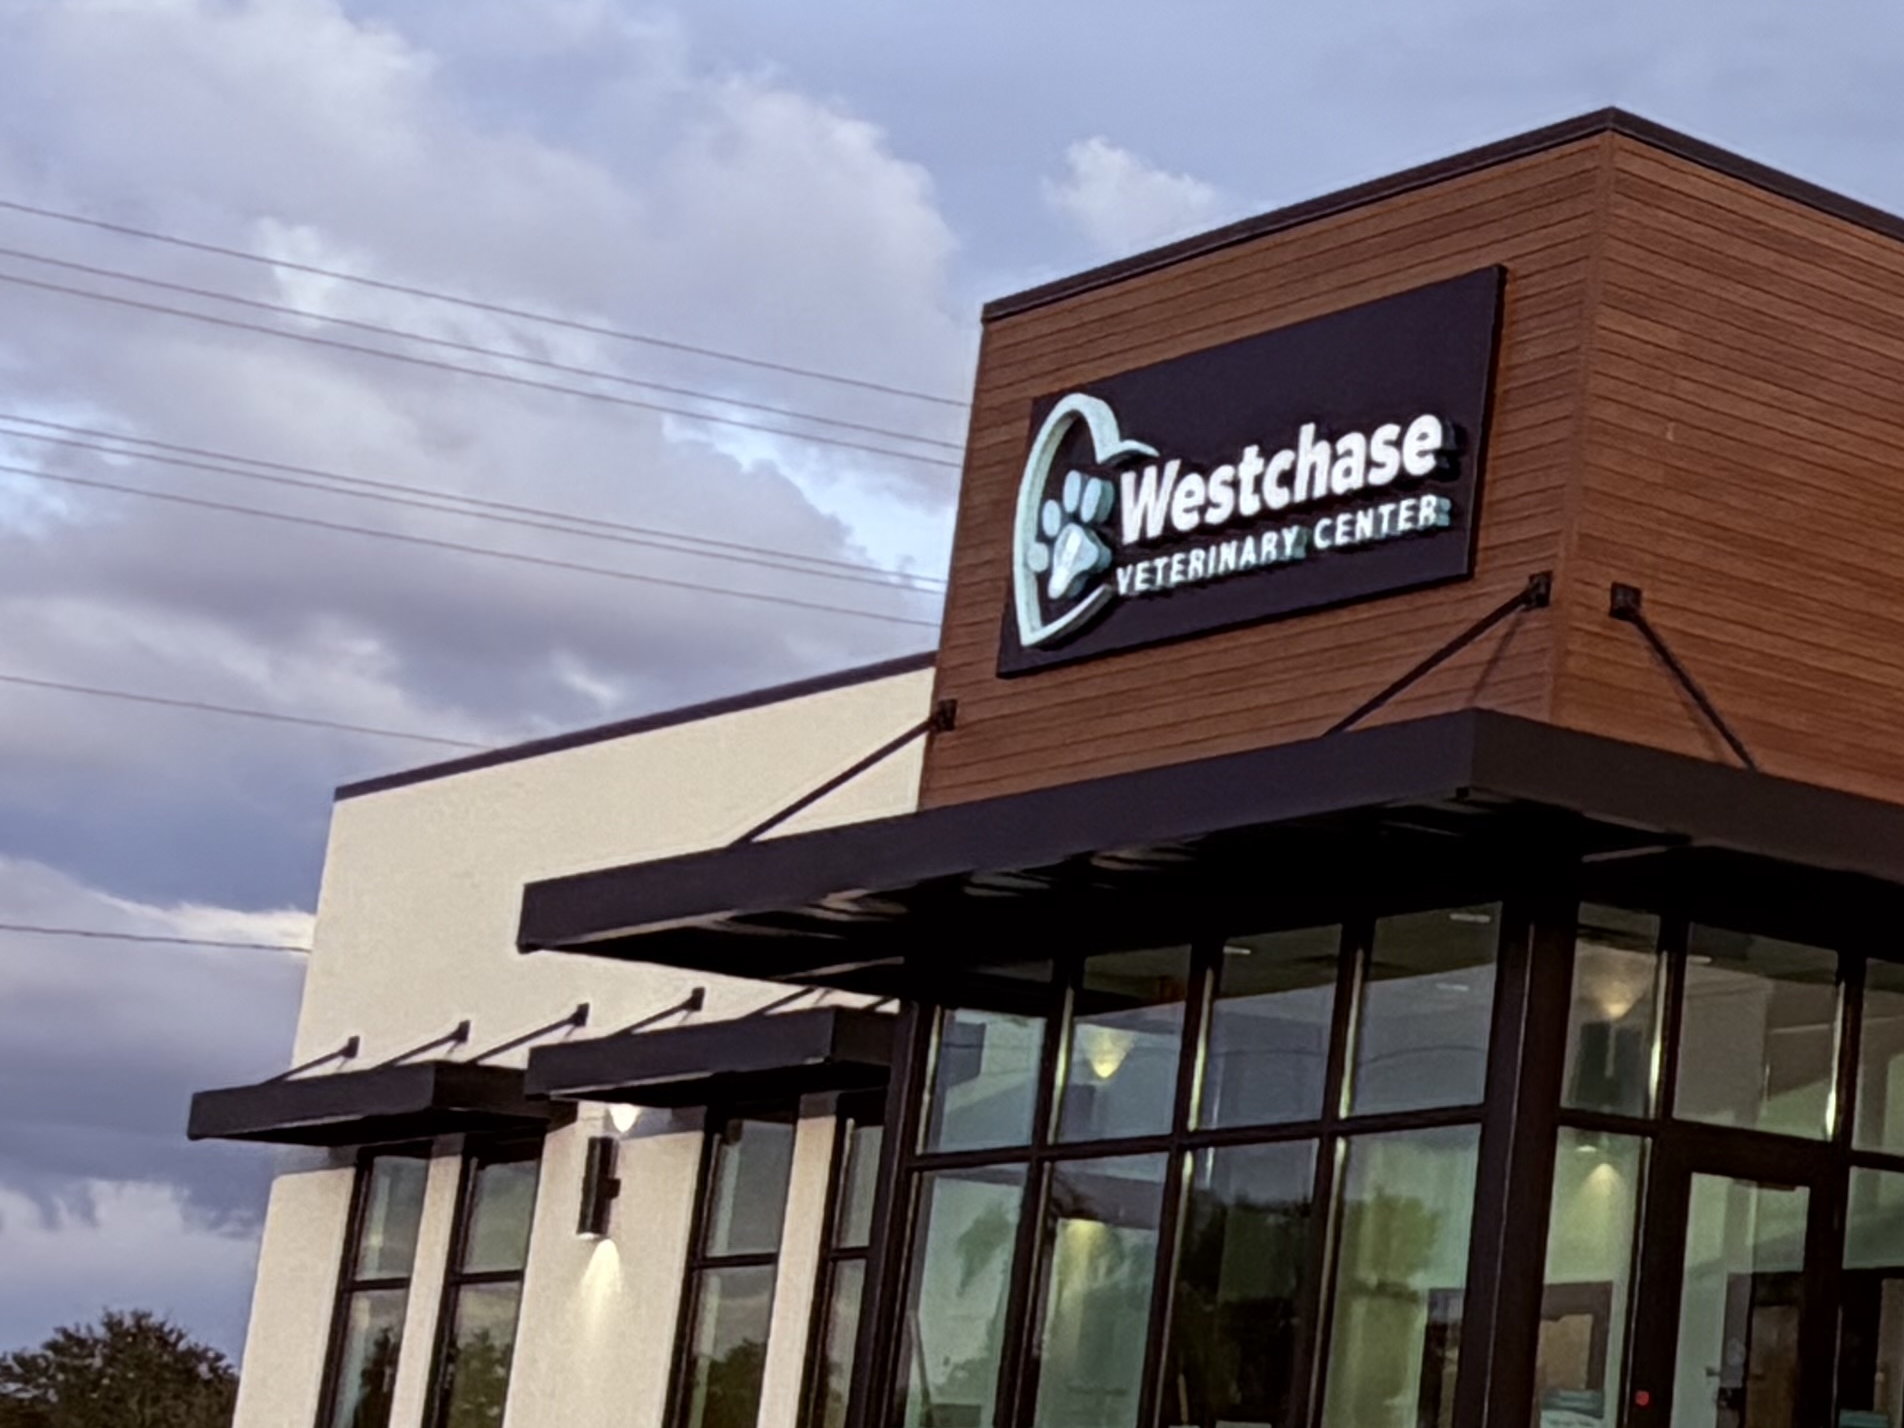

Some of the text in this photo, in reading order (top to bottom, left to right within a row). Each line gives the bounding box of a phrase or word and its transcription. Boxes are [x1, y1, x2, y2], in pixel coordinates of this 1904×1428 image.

[1119, 413, 1444, 546] Westchase
[1115, 493, 1445, 596] VETERINARY CENTER
